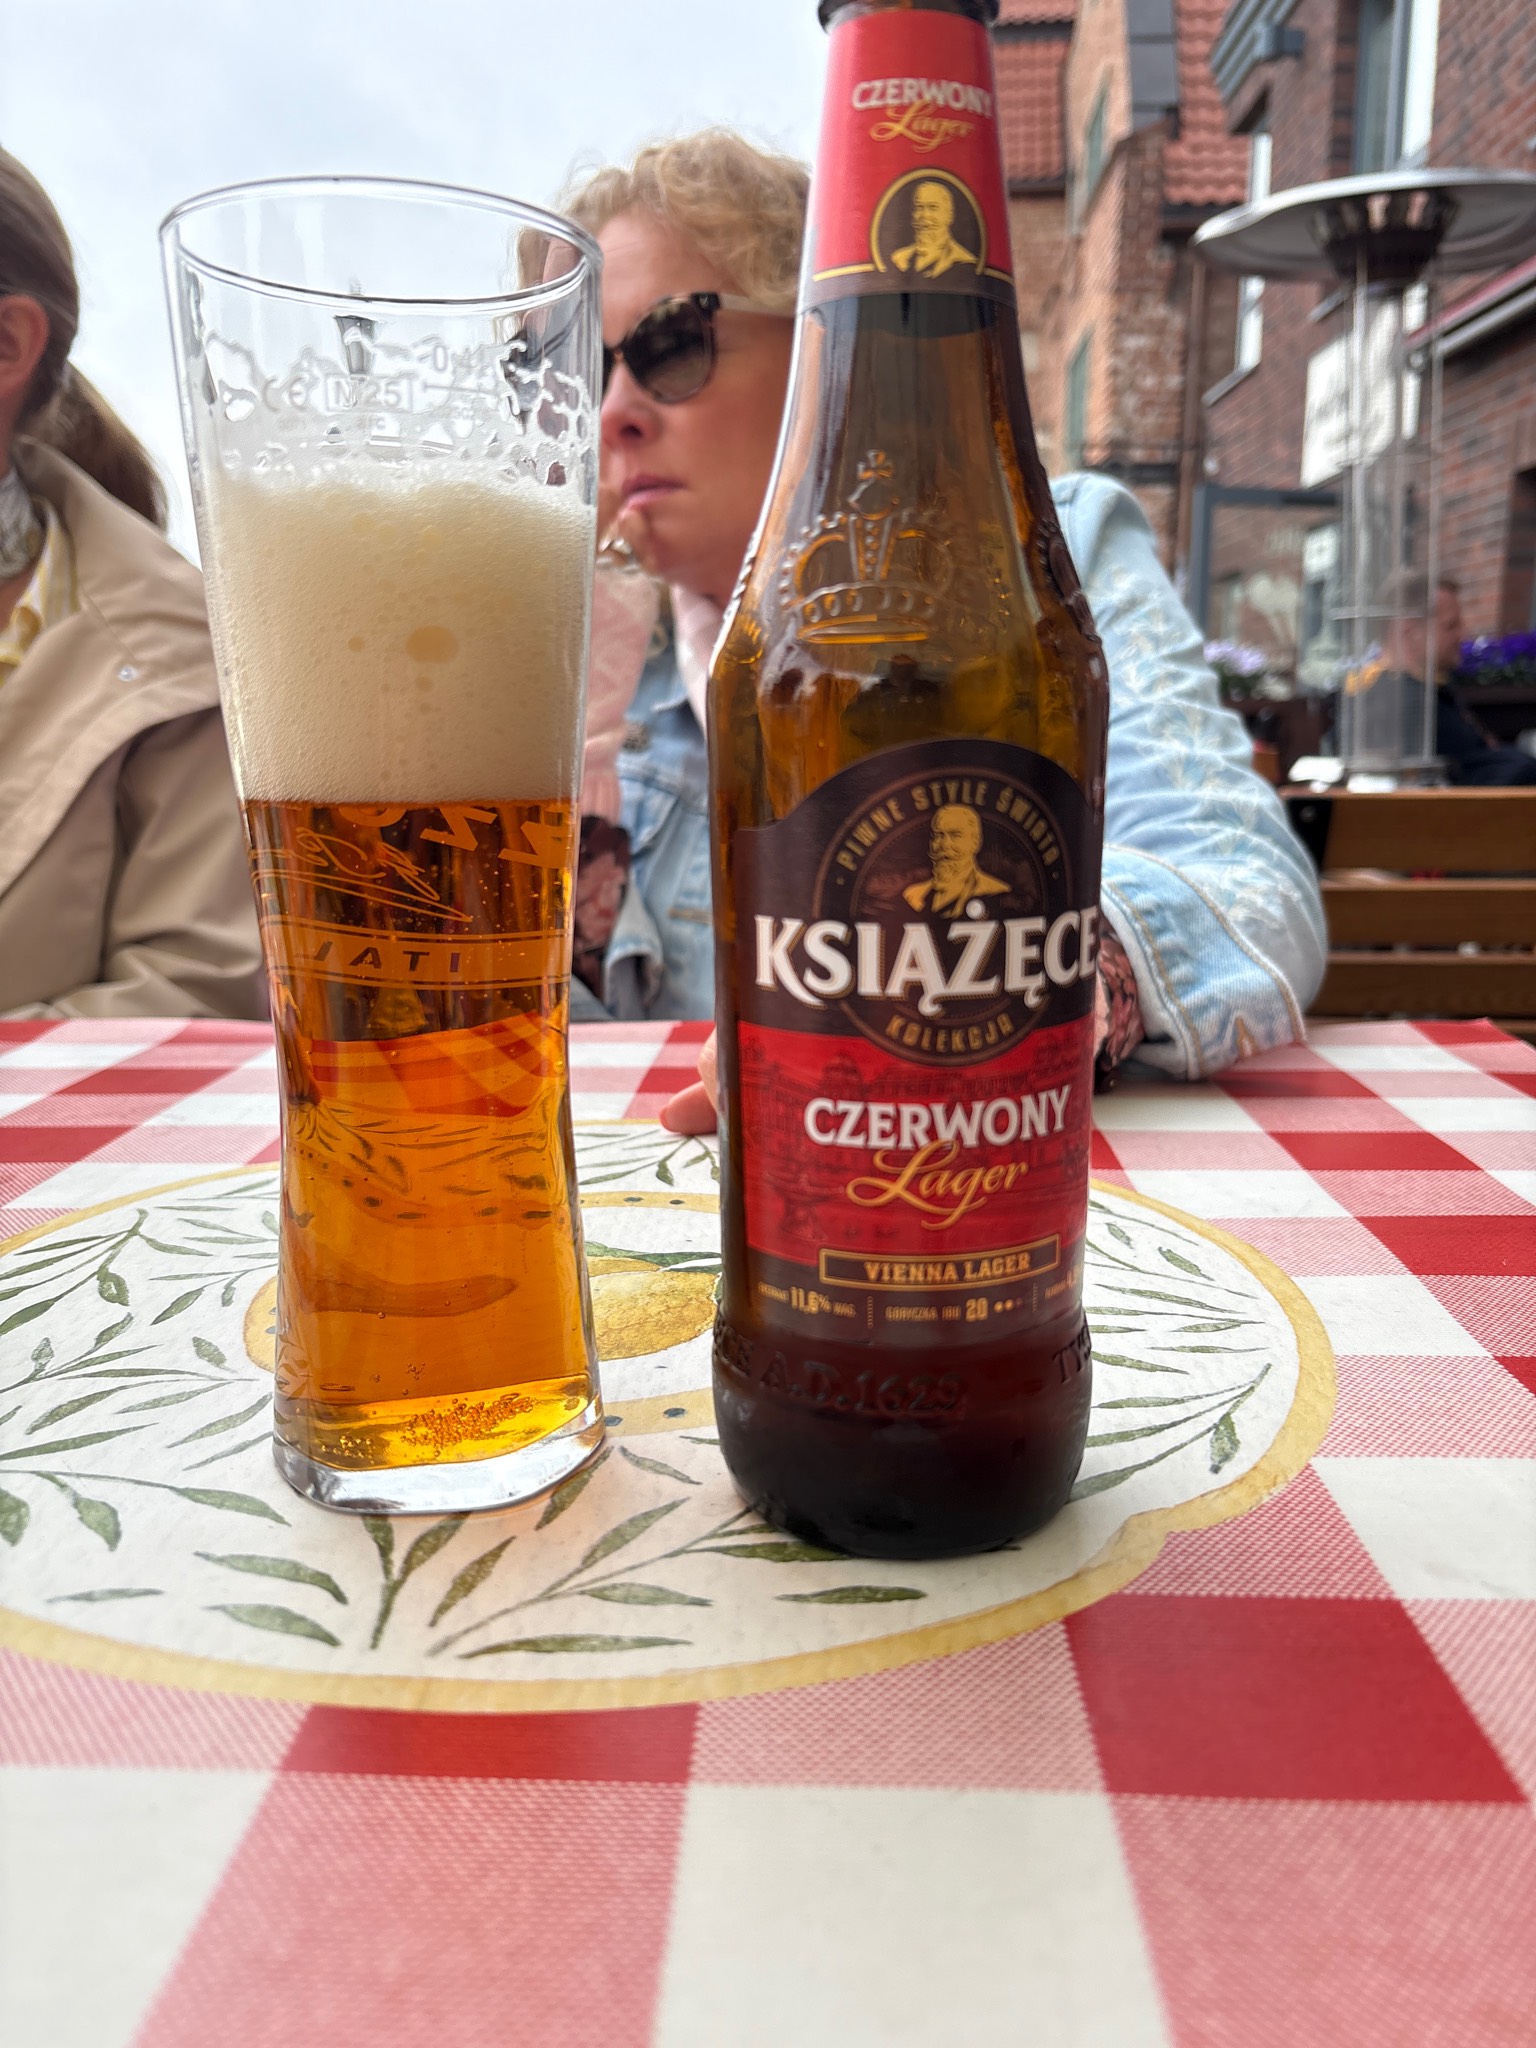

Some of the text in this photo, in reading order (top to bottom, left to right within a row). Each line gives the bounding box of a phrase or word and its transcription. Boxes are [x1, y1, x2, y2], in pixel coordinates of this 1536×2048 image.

[852, 77, 994, 118] CZERWONY
[869, 100, 977, 154] Lager
[836, 779, 1061, 871] PIWNE STYLE ŚWIATA
[754, 899, 1100, 1018] KSIĄŻĘCE
[885, 1012, 1014, 1053] KOLEKCJA
[803, 1084, 1072, 1150] CZERWONY
[845, 1138, 1029, 1232] Lager
[863, 1251, 1032, 1283] VIENNA LAGER
[965, 1297, 989, 1323] 20
